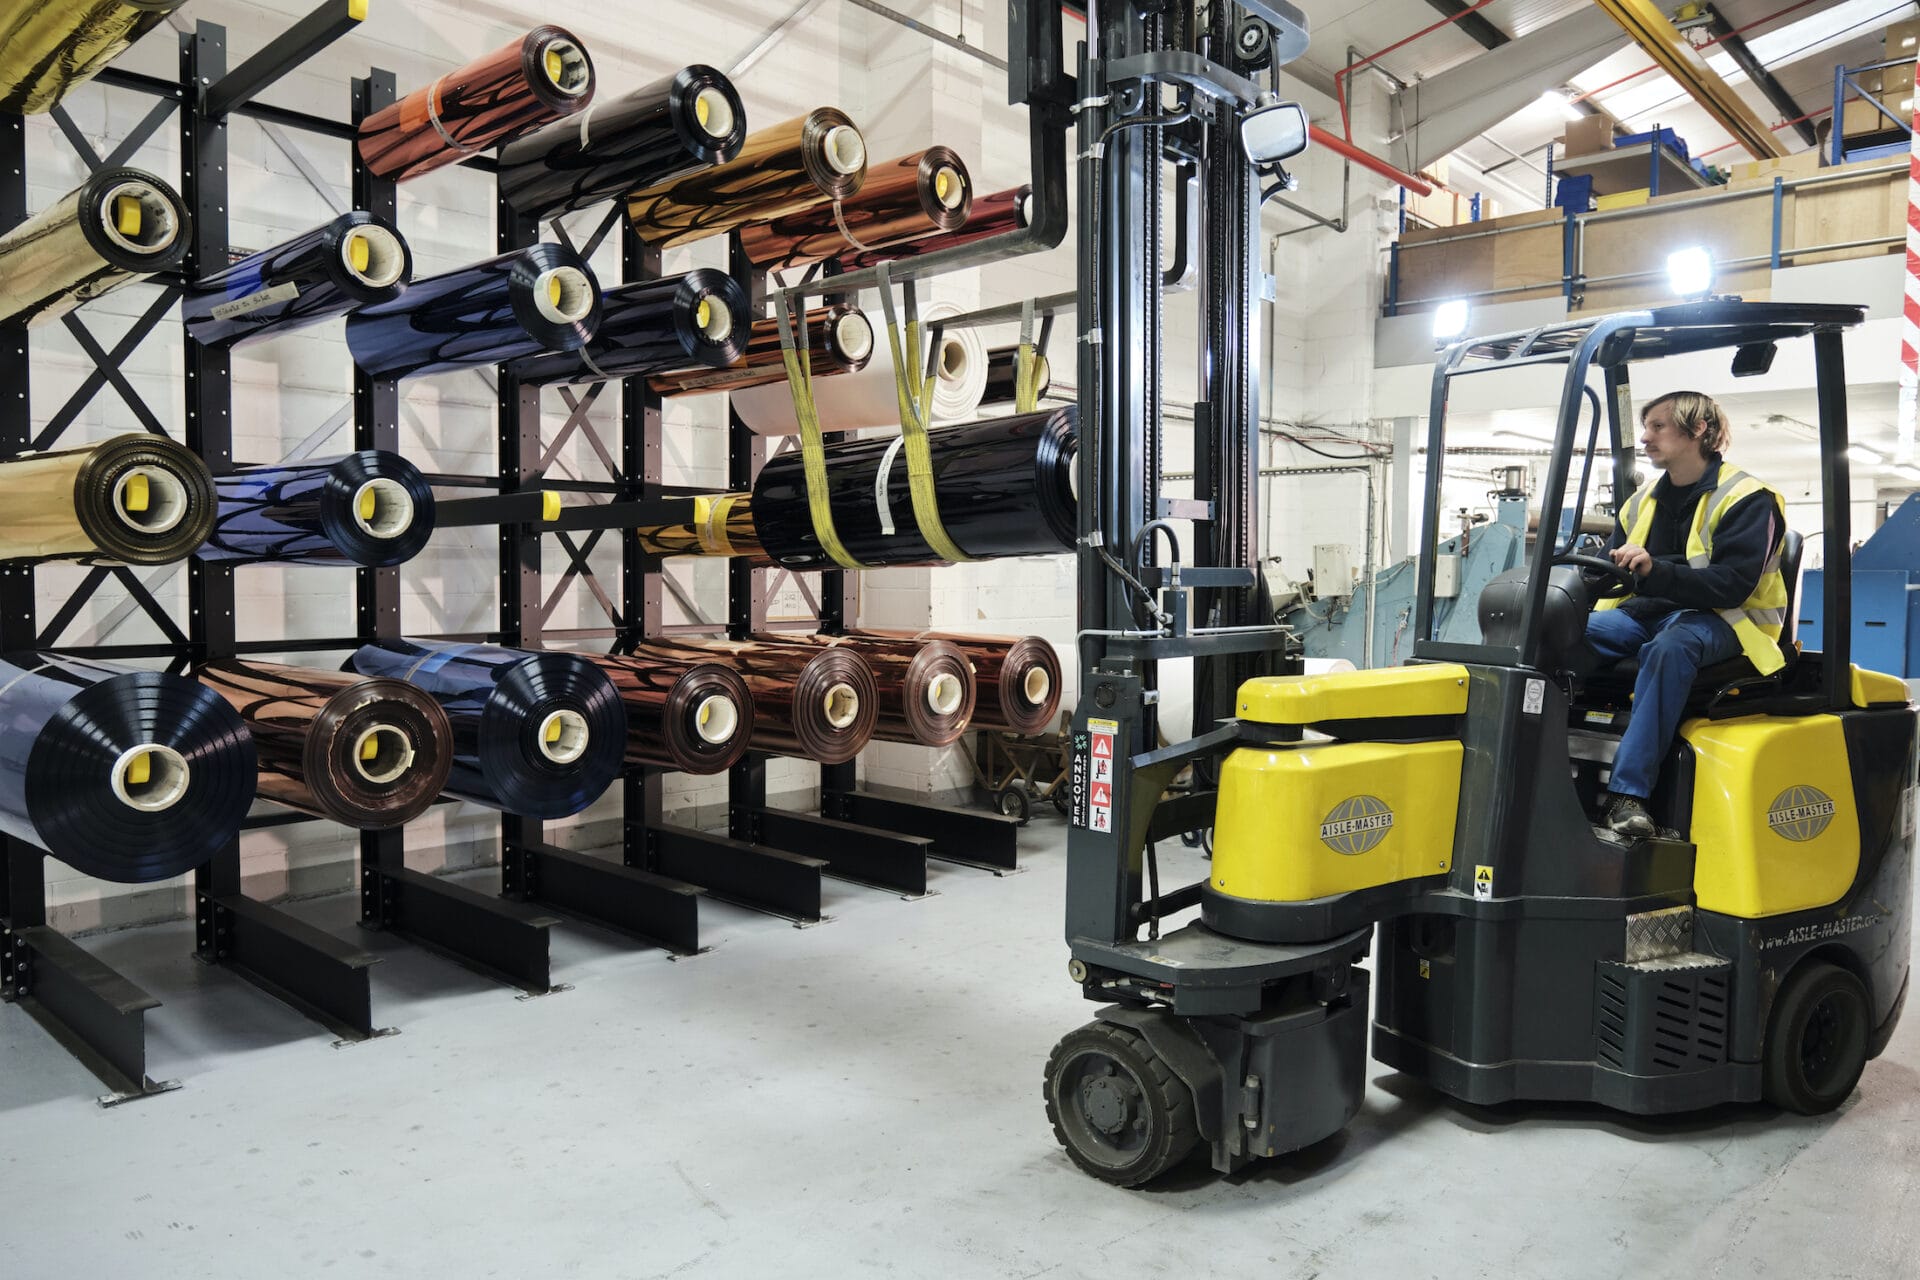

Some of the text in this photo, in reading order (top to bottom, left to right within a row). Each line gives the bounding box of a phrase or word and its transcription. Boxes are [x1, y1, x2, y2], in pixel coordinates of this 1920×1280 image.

[1073, 754, 1082, 826] ANDOVER
[1769, 803, 1834, 824] AISLE-MASTER
[1321, 814, 1392, 837] AISLE-MASTER
